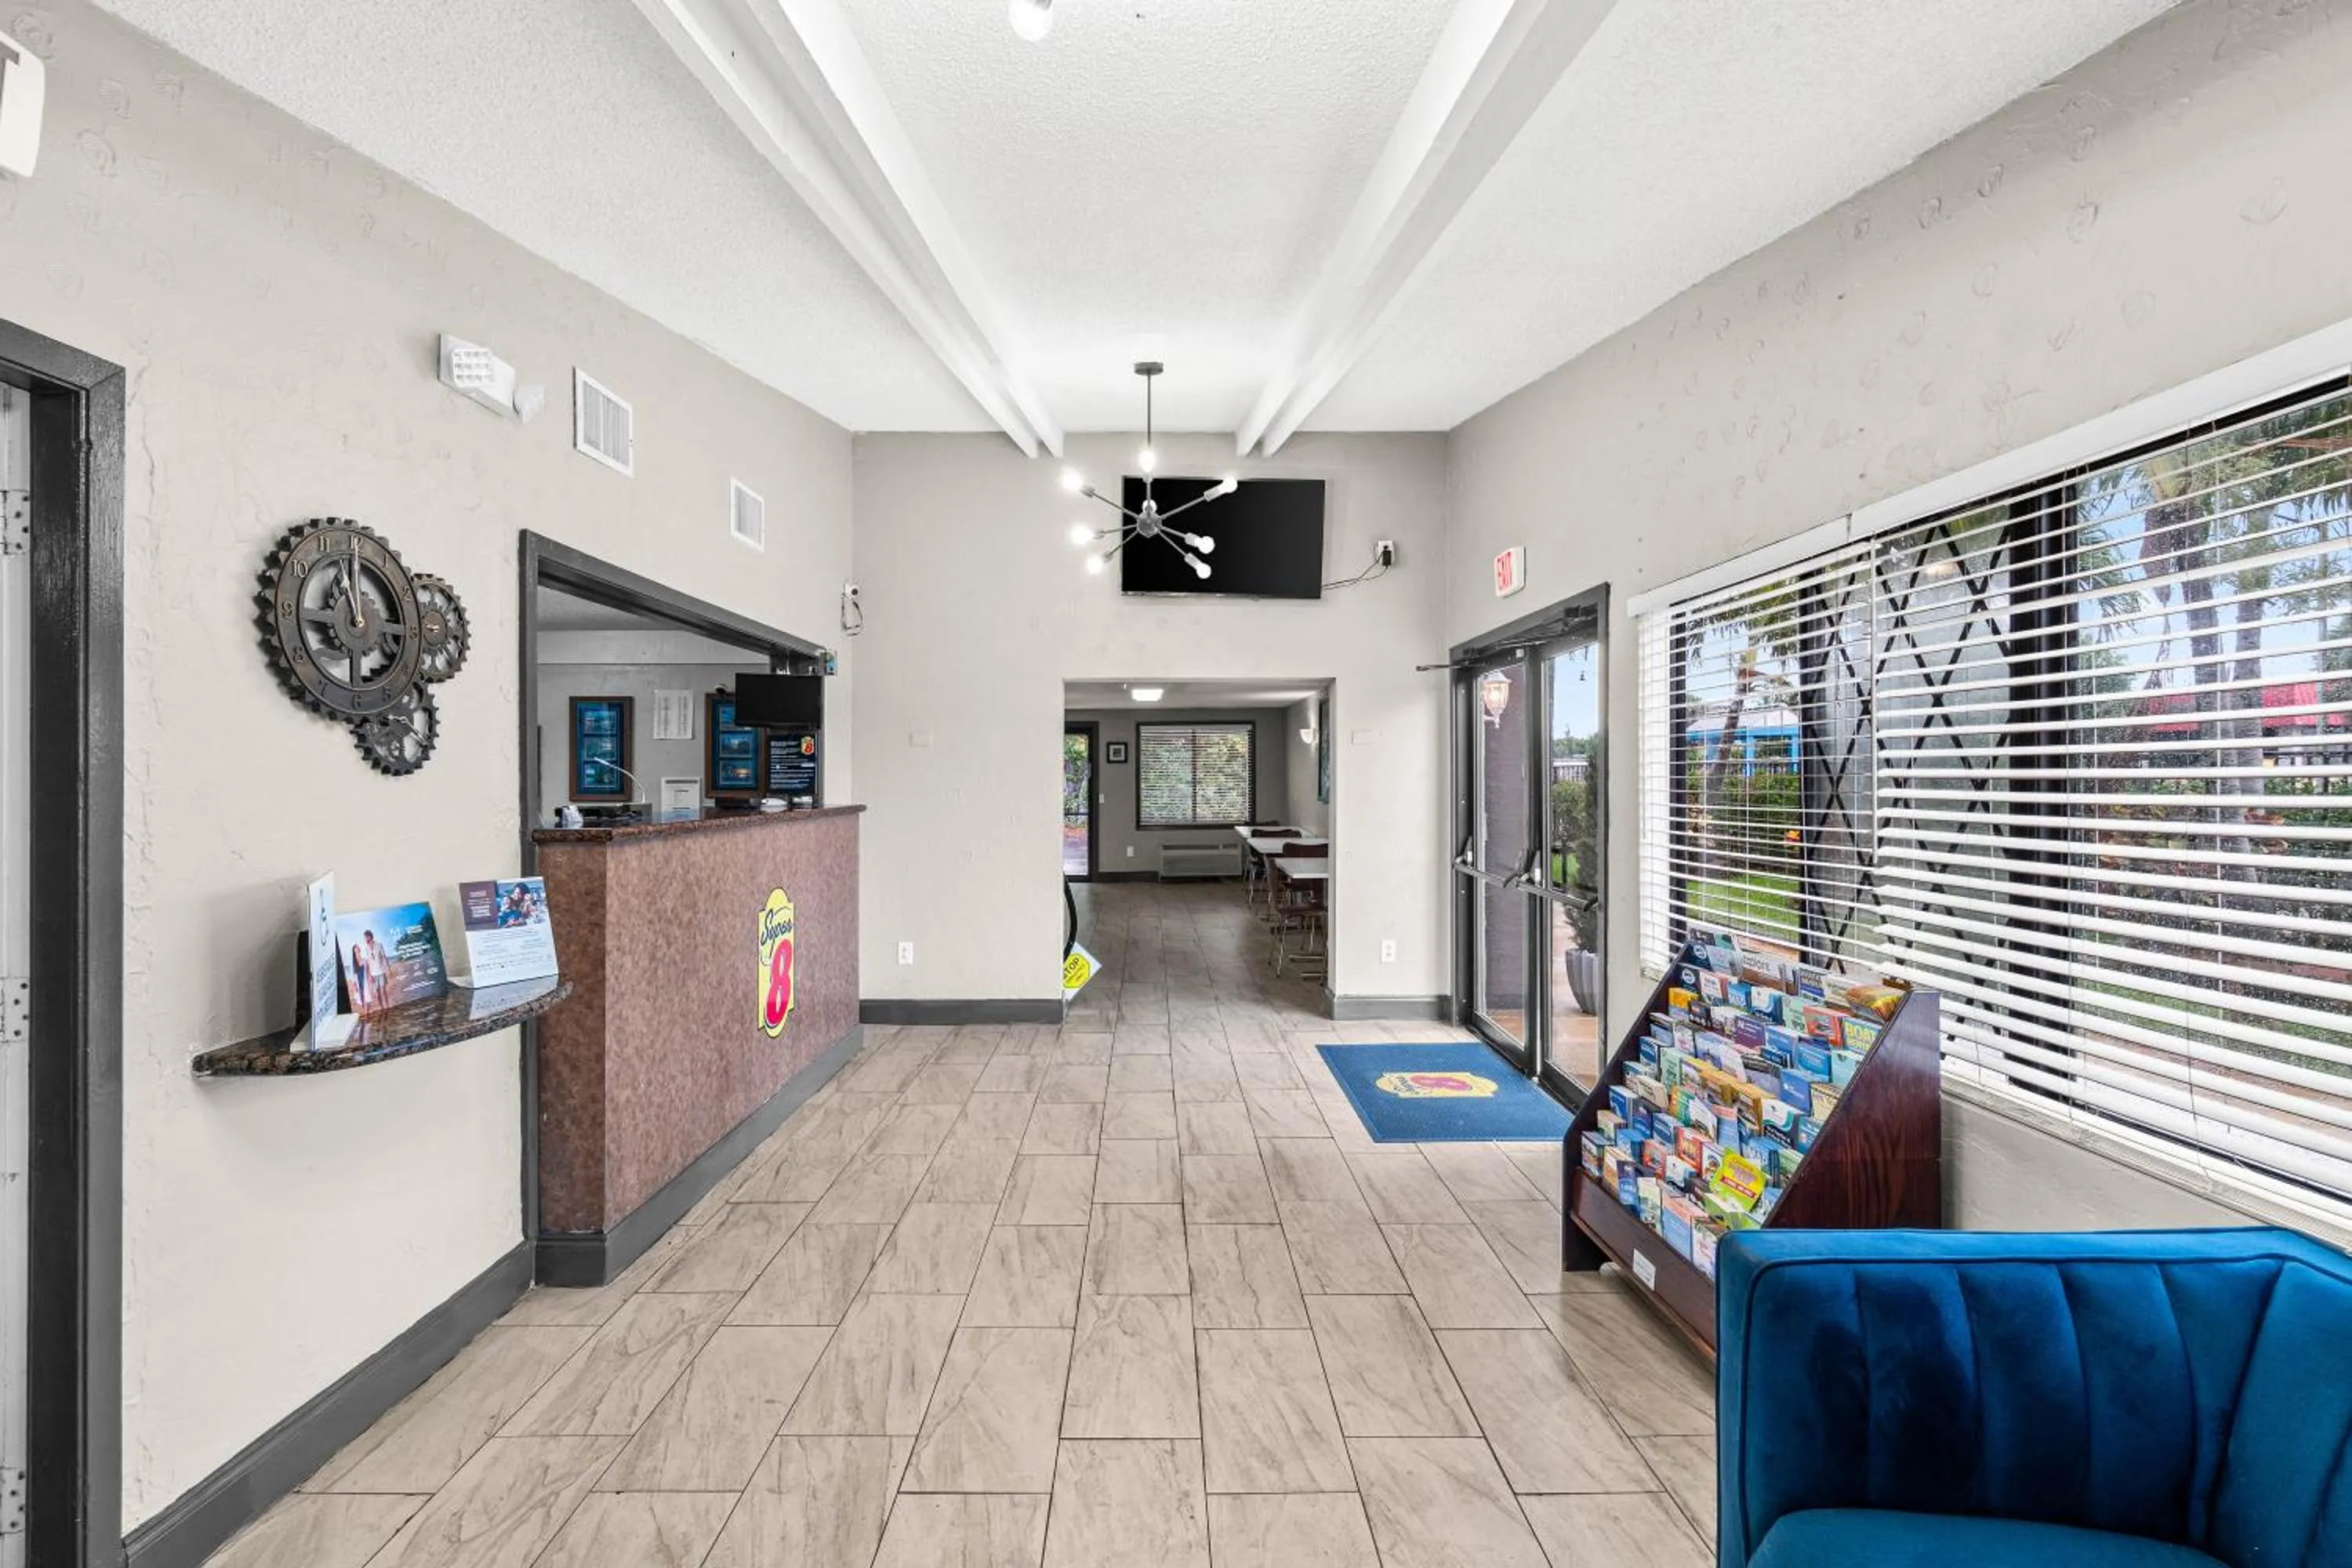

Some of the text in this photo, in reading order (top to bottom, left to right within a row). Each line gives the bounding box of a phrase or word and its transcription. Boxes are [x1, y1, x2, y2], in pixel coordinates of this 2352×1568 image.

[318, 535, 330, 552] 11
[350, 534, 364, 551] 12
[291, 560, 308, 578] 10
[401, 585, 412, 604] 2
[281, 601, 293, 619] 9
[409, 626, 419, 641] 3
[350, 693, 361, 710] 6
[760, 906, 793, 961] Super
[765, 938, 793, 1029] 8
